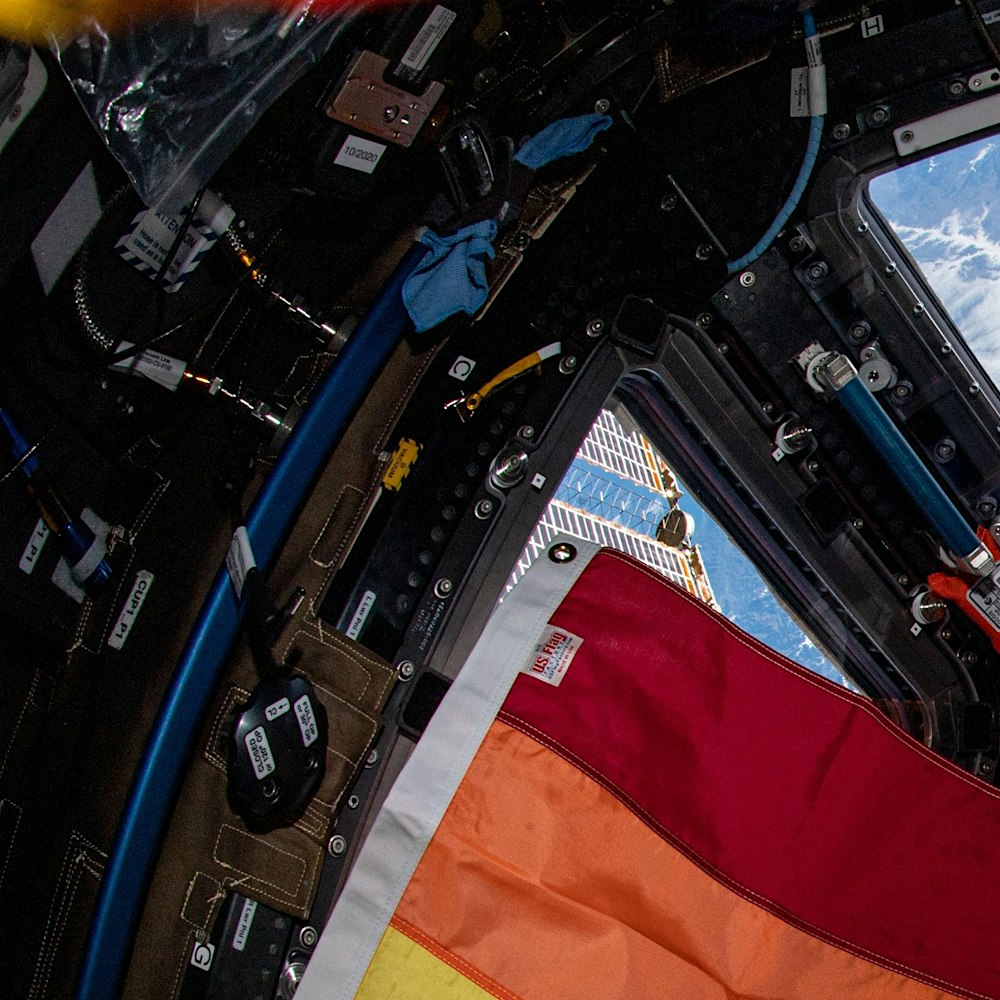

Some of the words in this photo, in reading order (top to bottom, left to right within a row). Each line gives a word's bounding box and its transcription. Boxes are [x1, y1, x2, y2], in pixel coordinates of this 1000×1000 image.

[864, 16, 880, 36] H
[344, 146, 378, 162] 10/2020
[454, 360, 471, 376] C
[388, 448, 408, 478] VACUUM
[116, 580, 147, 639] CUP1_P1
[360, 602, 369, 616] Lwr
[352, 618, 362, 630] Pnl
[532, 656, 548, 673] US
[542, 632, 568, 656] Flag
[558, 662, 566, 673] MADE
[566, 645, 574, 656] USA
[268, 707, 278, 716] CL
[302, 701, 312, 720] FULL
[310, 724, 316, 735] OP
[297, 704, 302, 712] or
[304, 730, 312, 740] OP
[254, 730, 263, 742] OP
[249, 738, 264, 773] CLOSED
[266, 764, 272, 772] or
[244, 908, 252, 922] Lwr
[239, 924, 247, 938] Pnl
[194, 944, 212, 966] G
